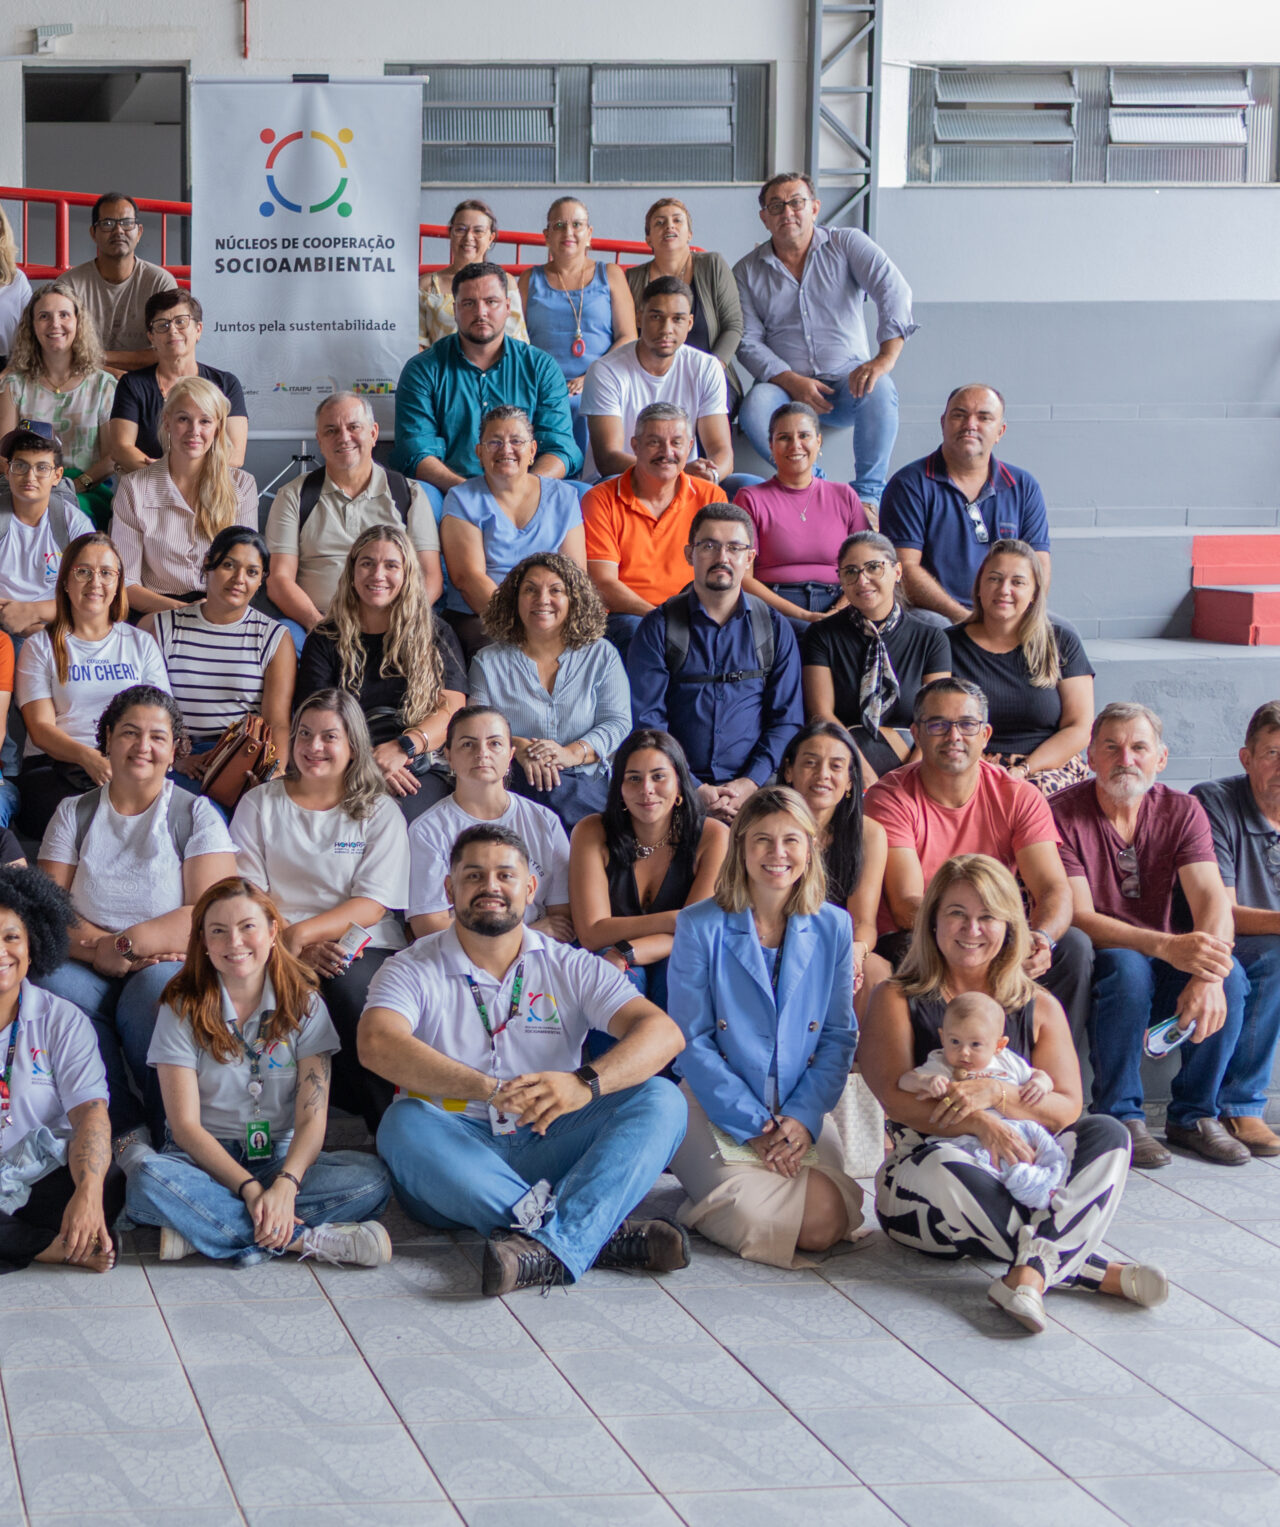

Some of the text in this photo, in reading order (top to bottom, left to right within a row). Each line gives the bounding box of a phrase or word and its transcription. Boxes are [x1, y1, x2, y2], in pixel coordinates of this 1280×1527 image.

[215, 234, 395, 253] NÚCLEOS DE COOPERAÇÃO
[214, 256, 396, 273] SOCIOAMBIENTAL
[214, 319, 397, 335] Juntos pela sustentabilidade
[68, 663, 139, 682] ON CHERI.
